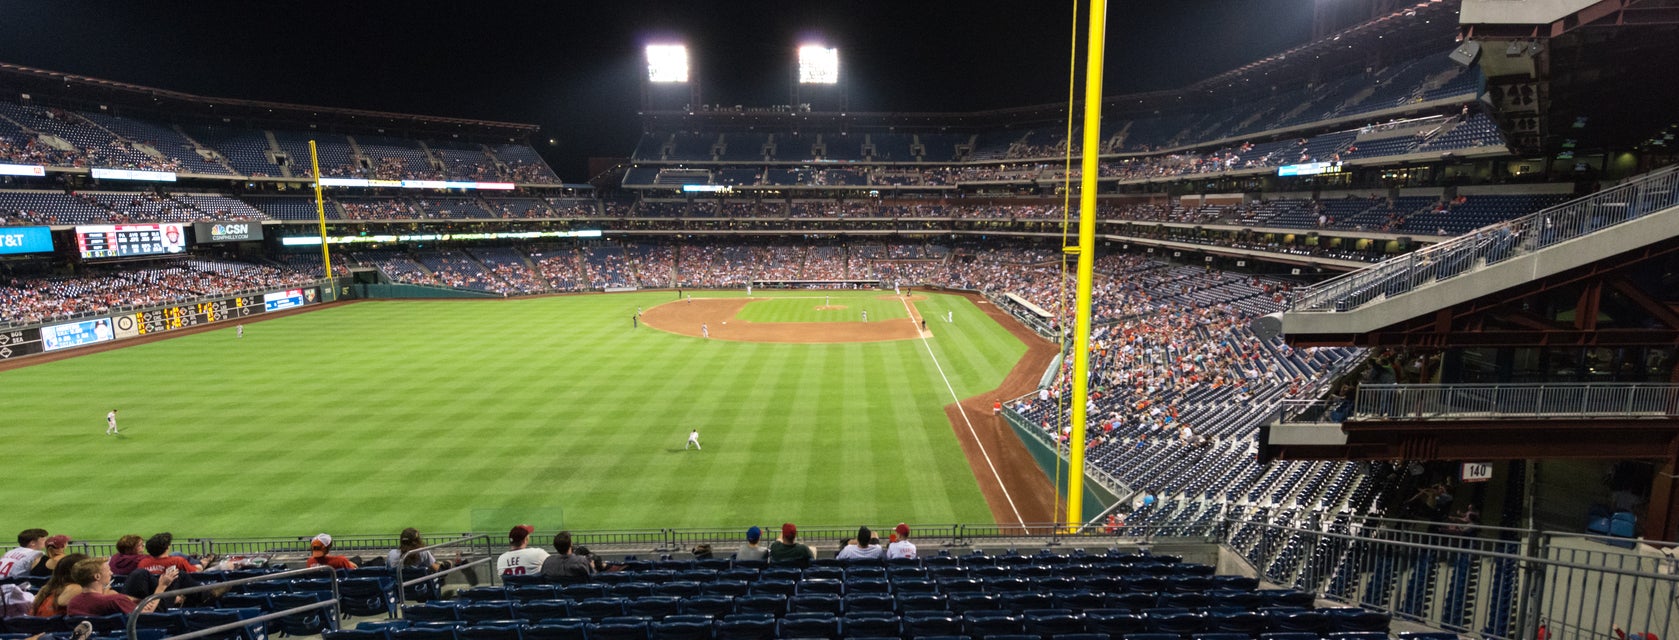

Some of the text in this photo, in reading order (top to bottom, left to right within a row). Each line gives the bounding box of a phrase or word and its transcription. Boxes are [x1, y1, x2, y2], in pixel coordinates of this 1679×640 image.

[226, 224, 248, 234] CSN
[1470, 464, 1486, 477] 140
[507, 557, 520, 567] LEE
